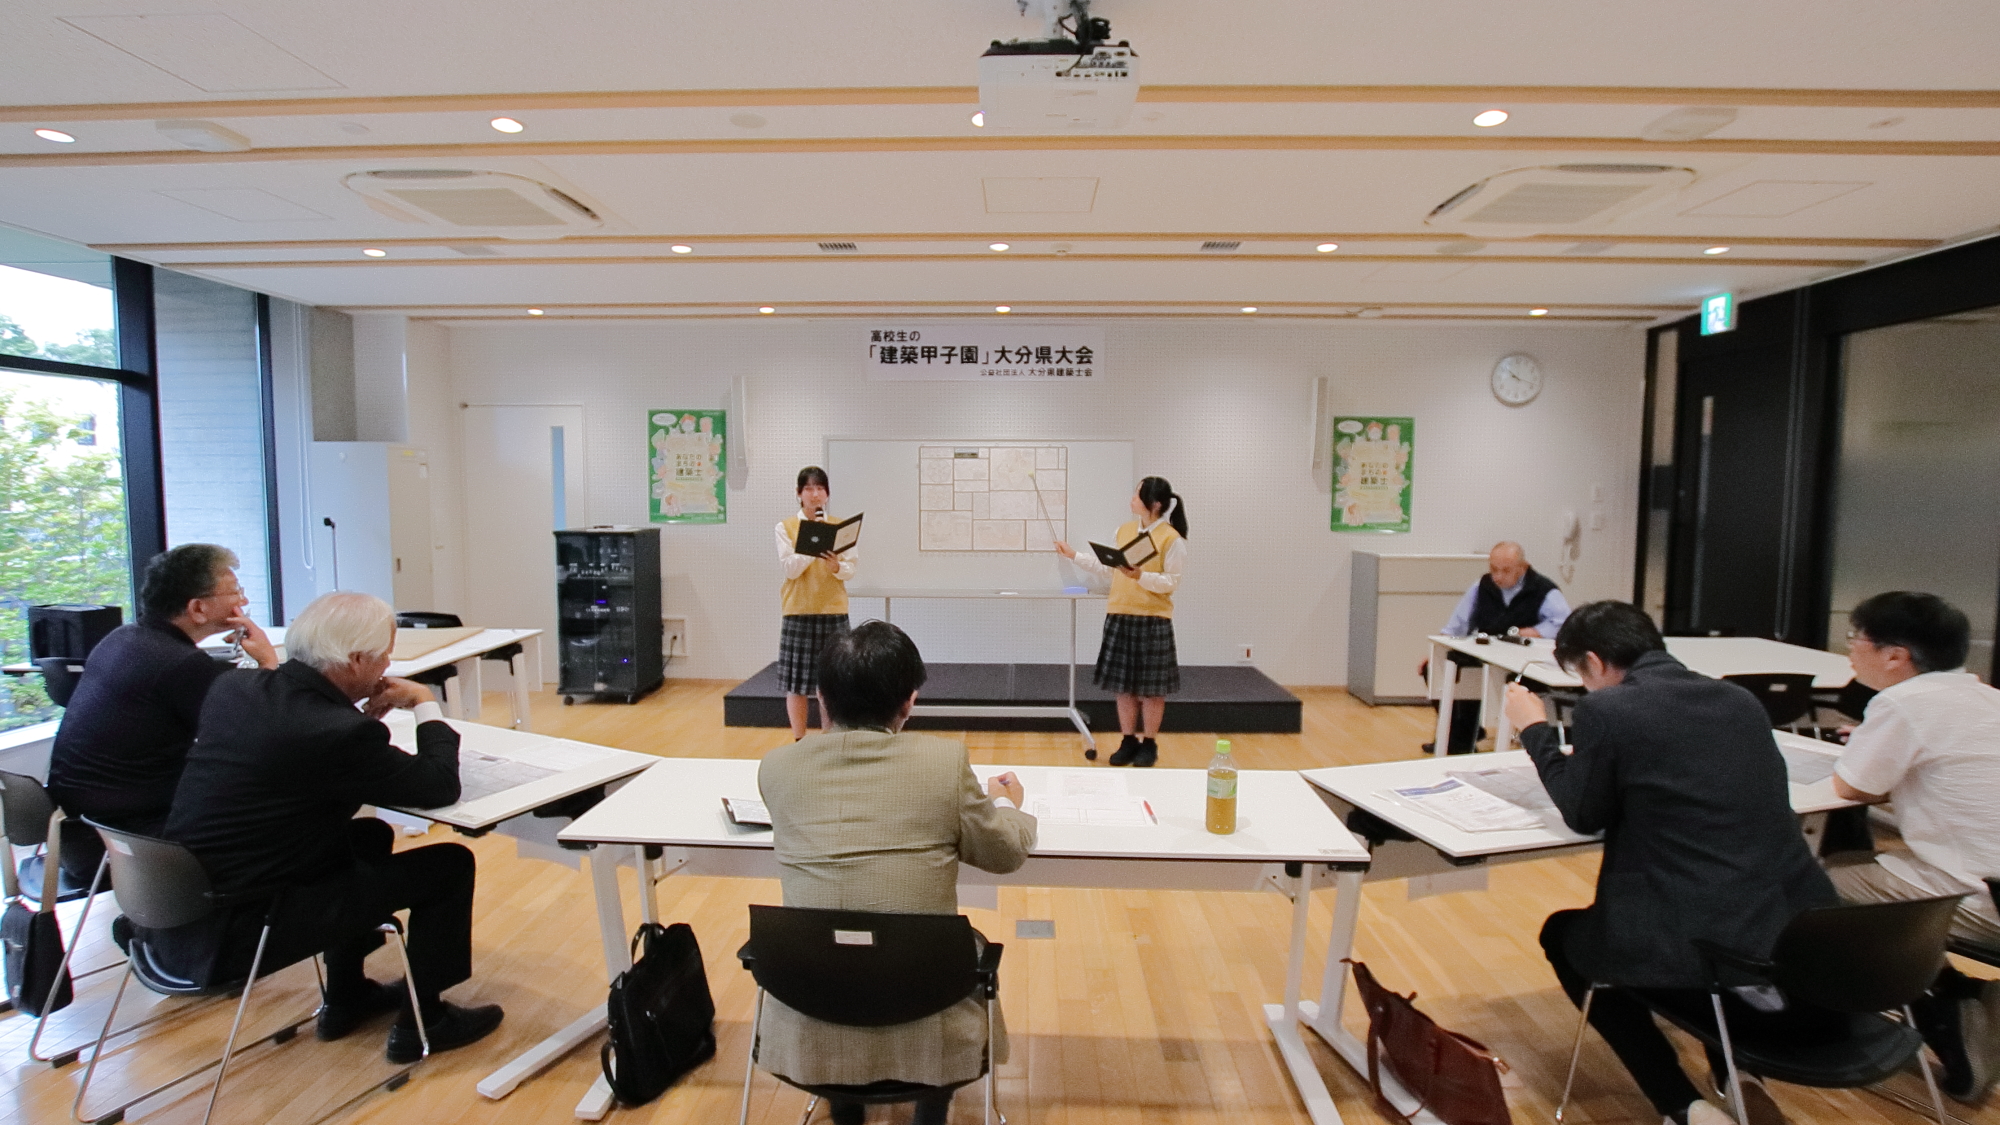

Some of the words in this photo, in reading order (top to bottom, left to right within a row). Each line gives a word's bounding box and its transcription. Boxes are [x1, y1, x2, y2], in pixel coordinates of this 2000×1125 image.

[871, 330, 921, 342] 高校生の
[869, 345, 1094, 364] 「建築甲子園」大分県大会
[1028, 368, 1093, 376] 大分県建築士会
